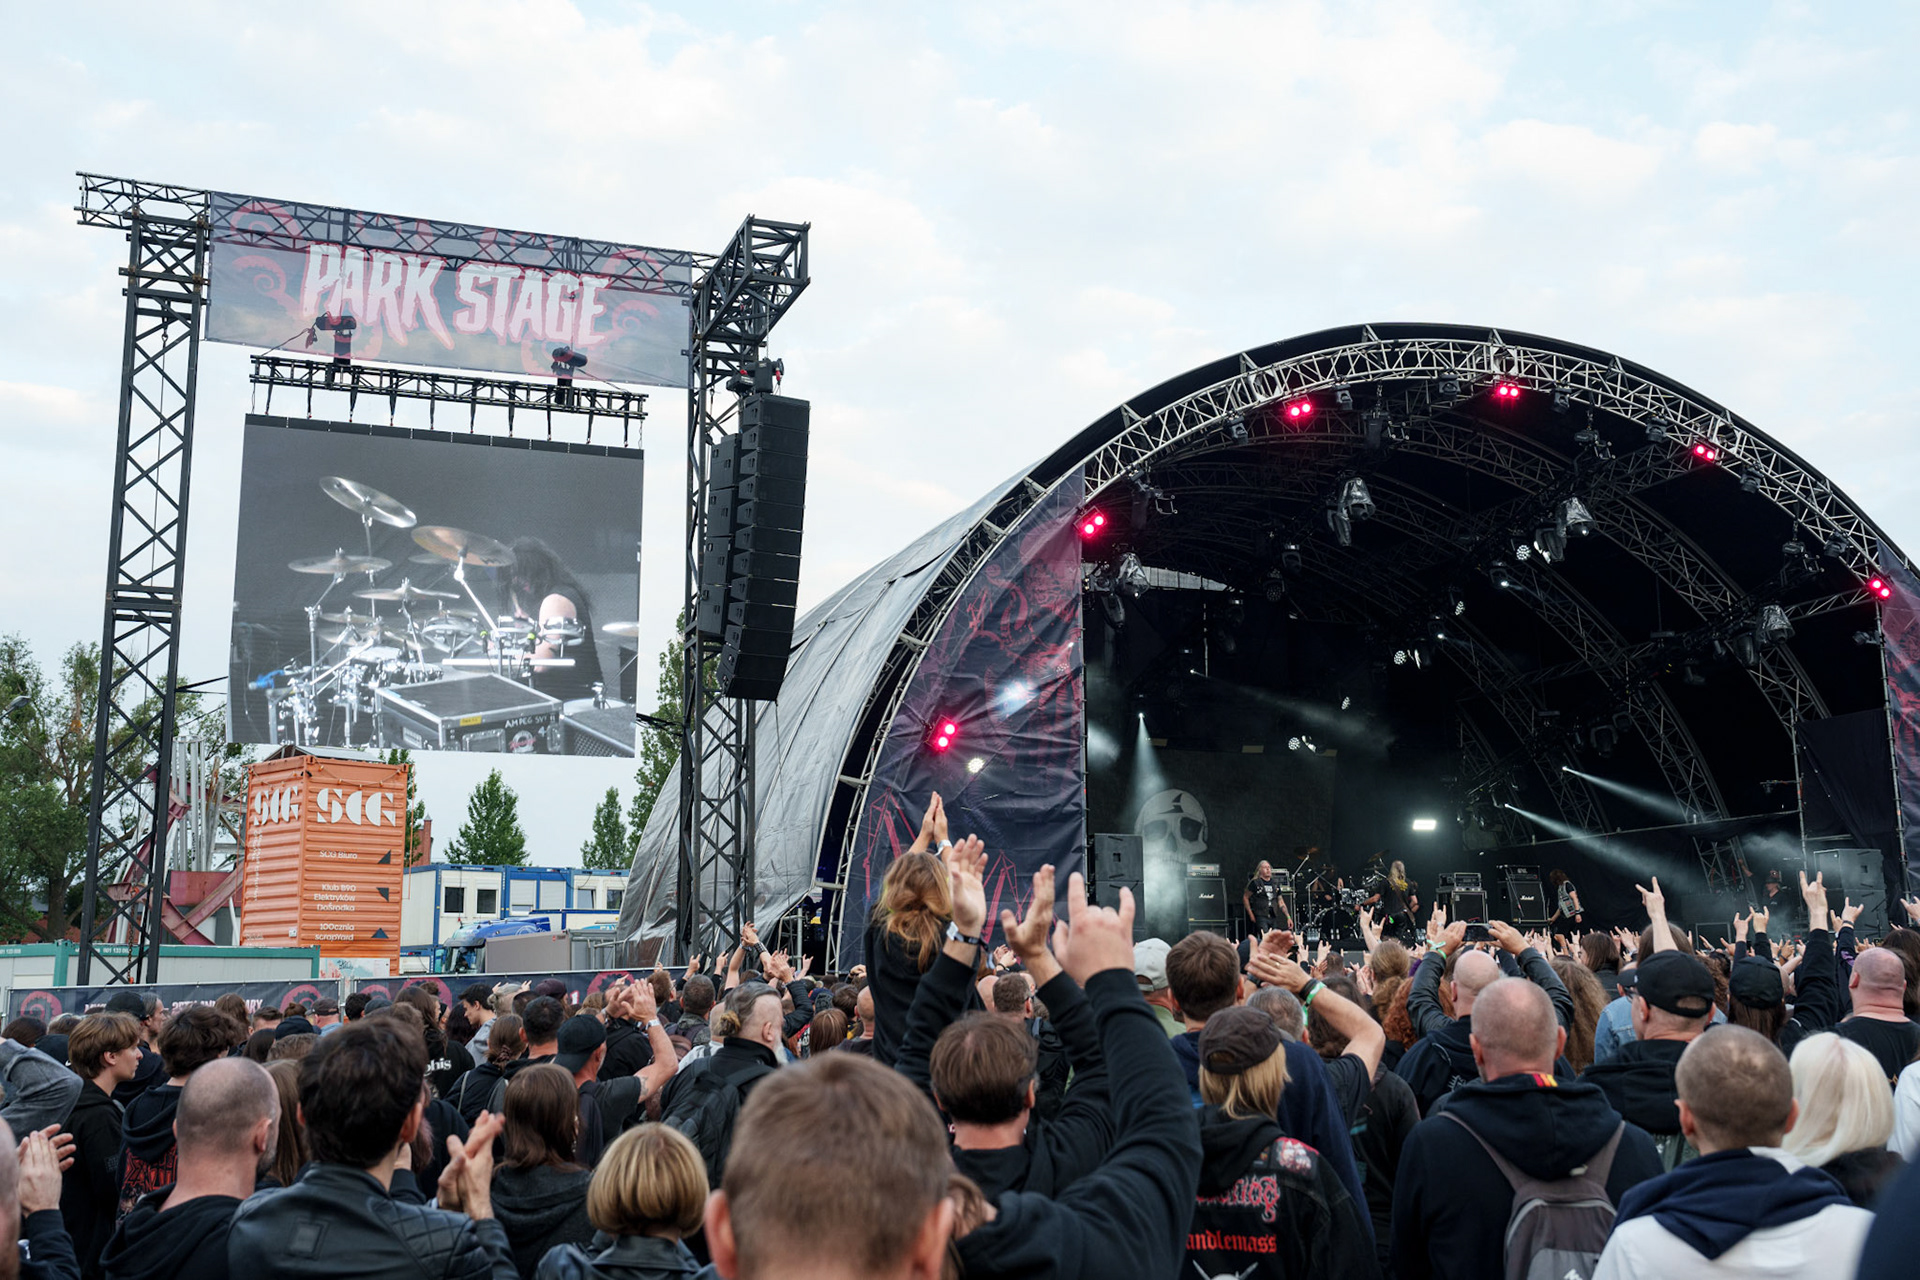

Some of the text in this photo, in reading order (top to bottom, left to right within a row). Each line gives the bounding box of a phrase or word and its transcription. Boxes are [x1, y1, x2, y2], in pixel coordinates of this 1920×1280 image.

[302, 243, 609, 349] PARK STAGE
[254, 786, 299, 826] SCG
[316, 788, 396, 827] SCG
[338, 851, 358, 859] Biuro
